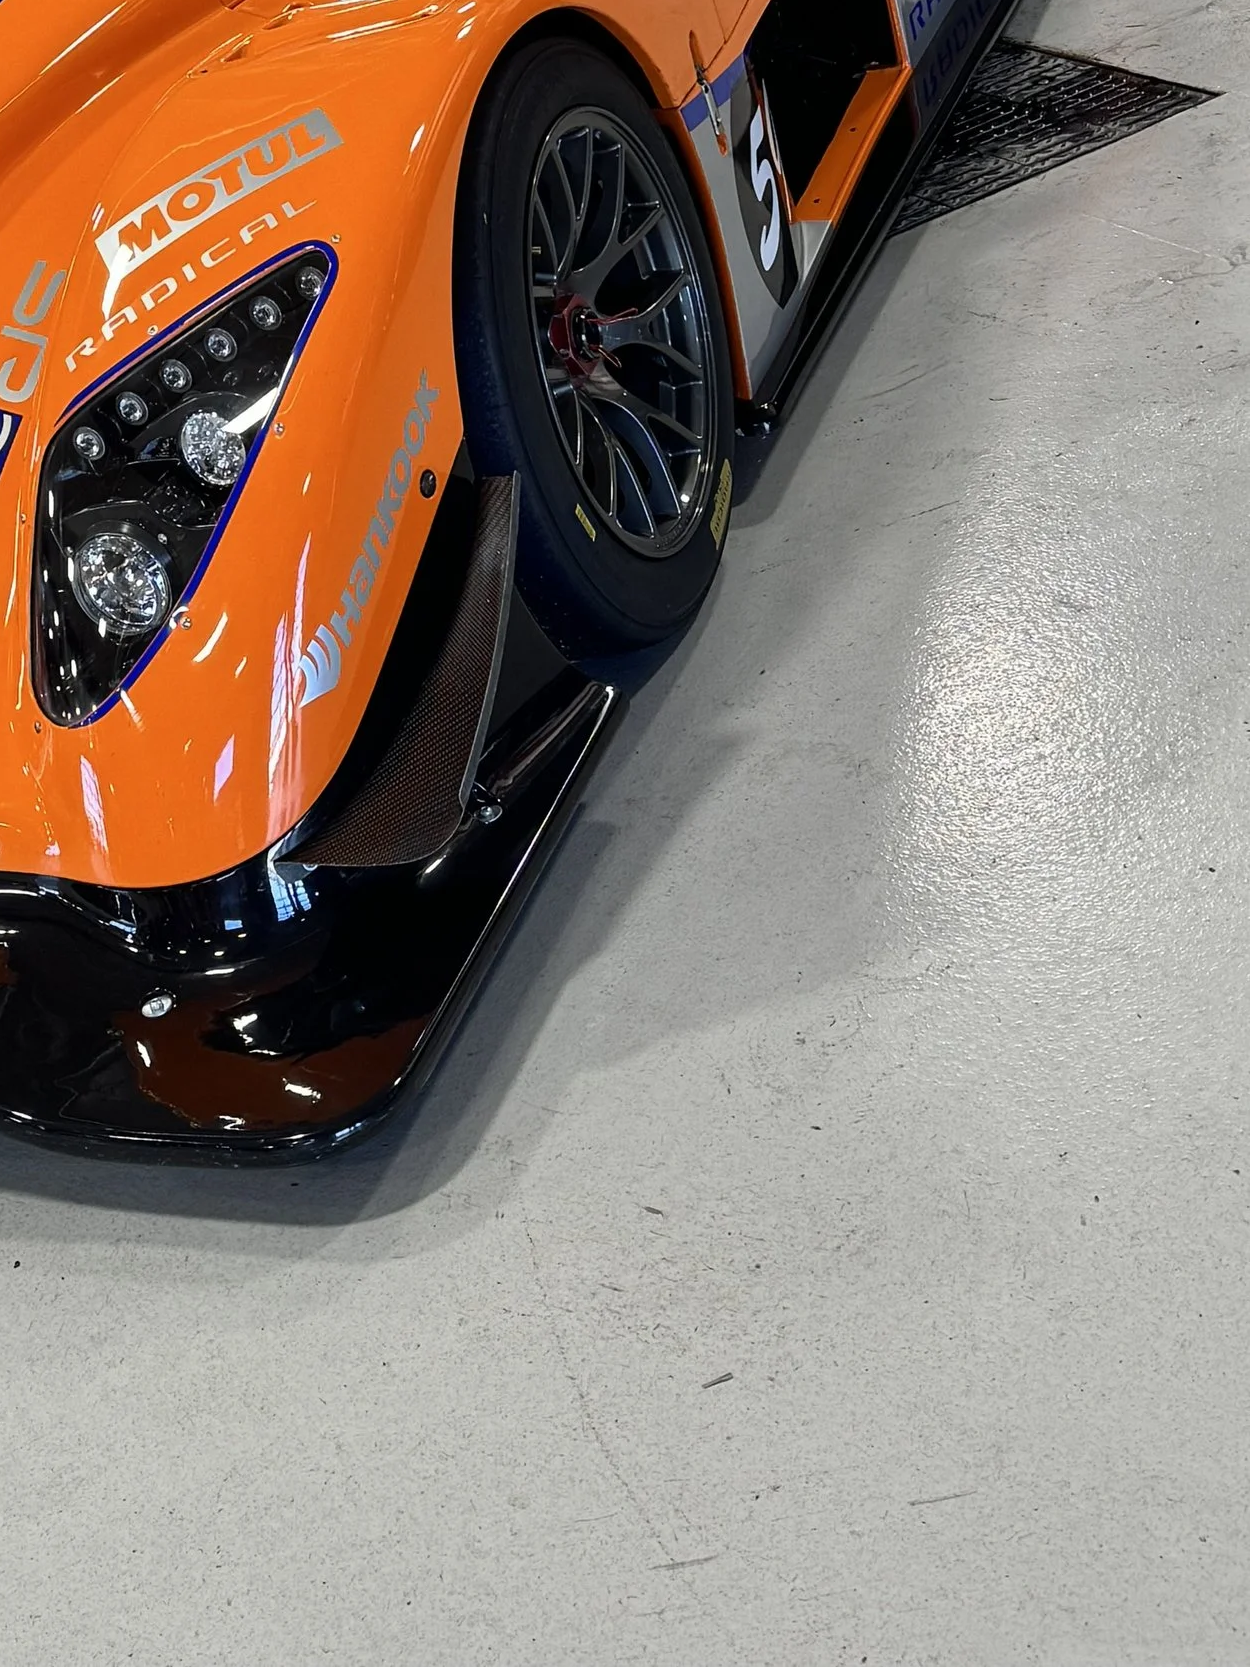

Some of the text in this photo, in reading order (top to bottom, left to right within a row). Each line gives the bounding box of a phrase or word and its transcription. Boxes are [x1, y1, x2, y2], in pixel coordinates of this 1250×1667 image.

[117, 121, 327, 260] MOTUL
[750, 78, 783, 272] 5
[64, 199, 318, 373] RADICAL
